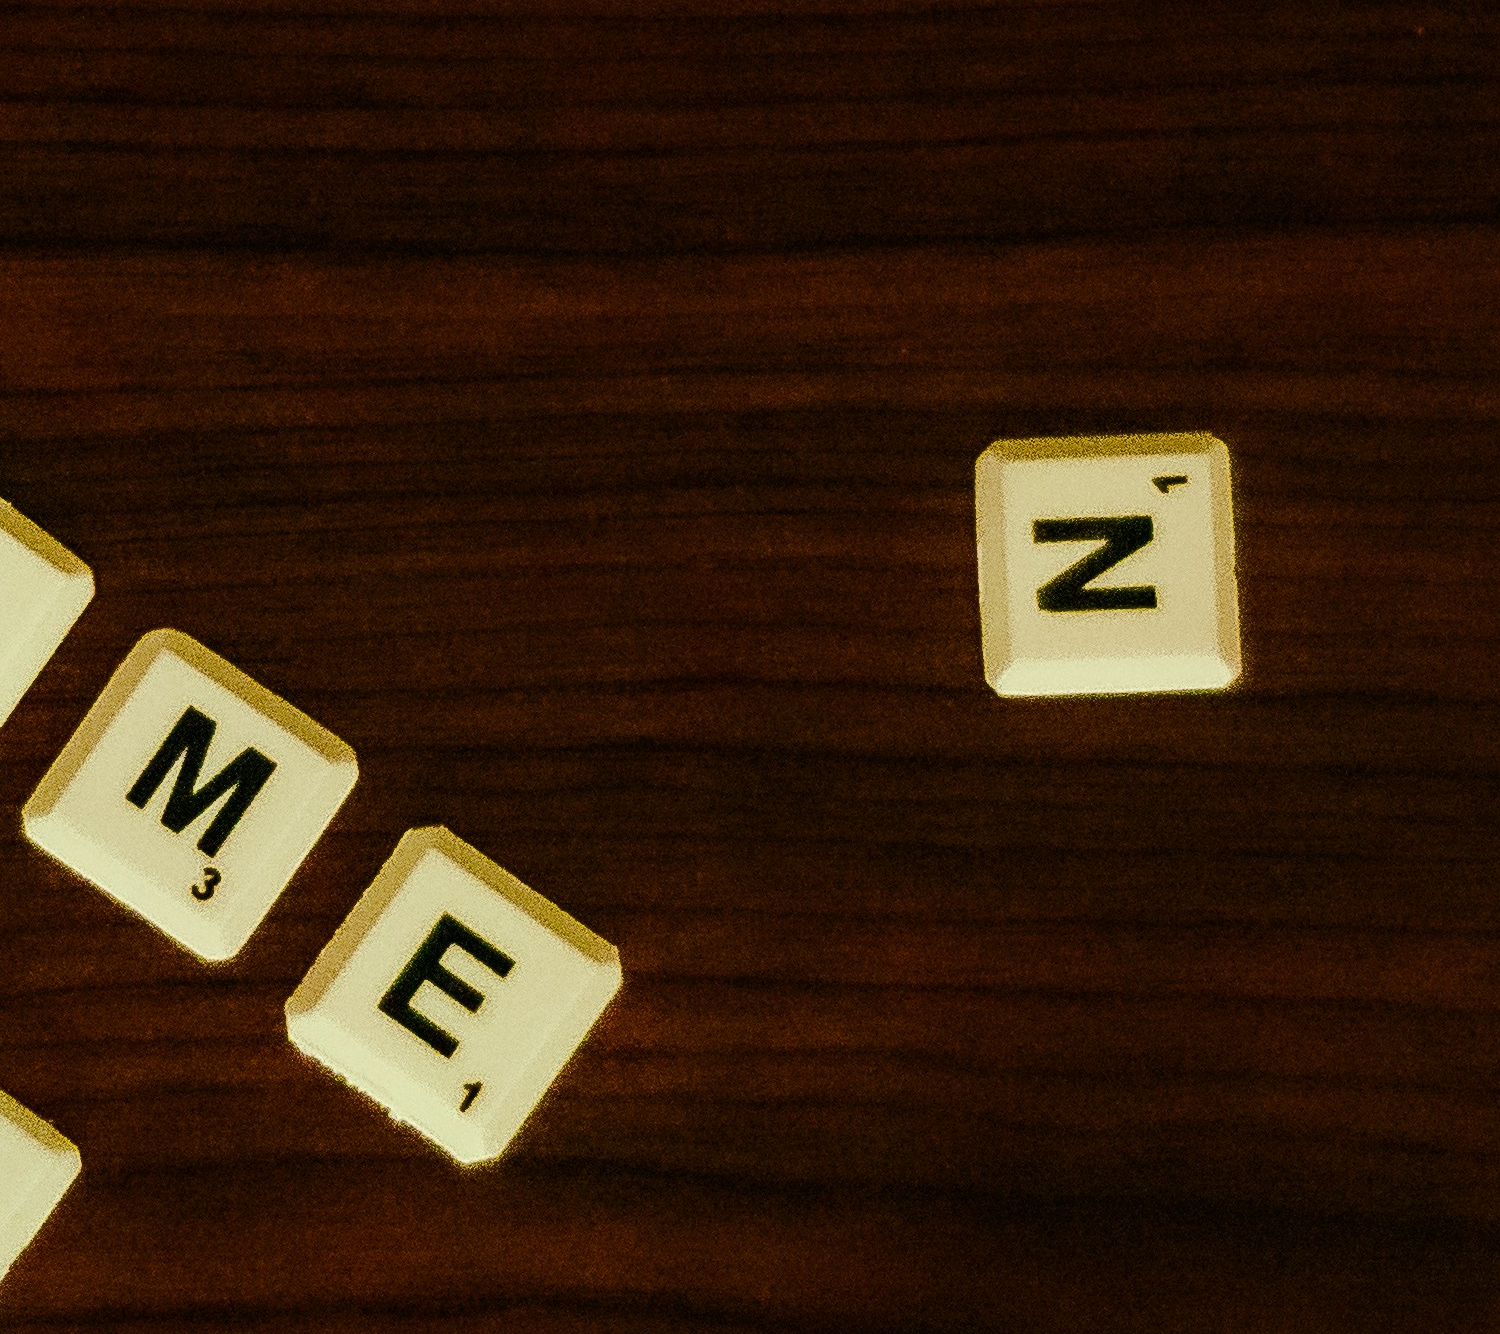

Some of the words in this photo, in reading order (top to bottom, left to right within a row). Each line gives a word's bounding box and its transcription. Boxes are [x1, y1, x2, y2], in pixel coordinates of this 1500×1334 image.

[1154, 476, 1187, 493] 1
[191, 867, 221, 901] 3
[461, 1083, 481, 1111] 1
